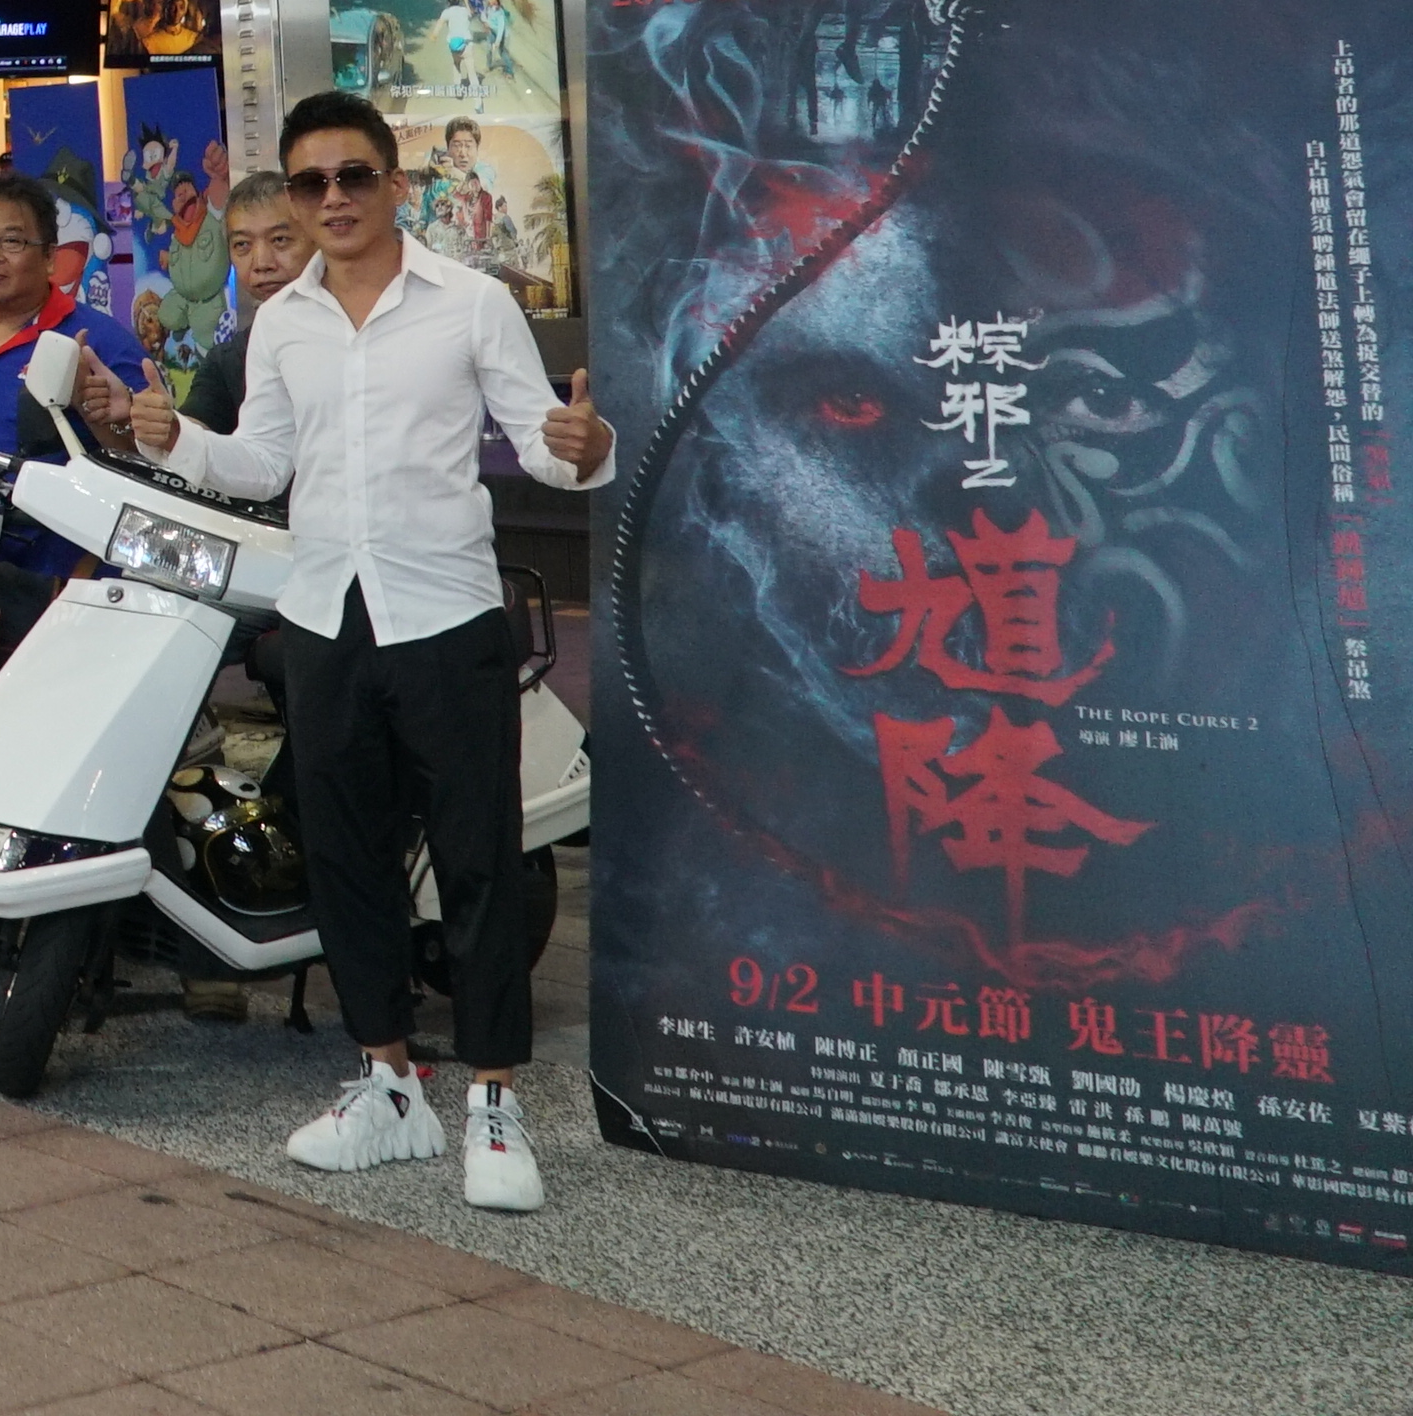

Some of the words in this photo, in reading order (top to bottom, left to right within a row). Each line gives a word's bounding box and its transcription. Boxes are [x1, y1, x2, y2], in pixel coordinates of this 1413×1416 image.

[151, 471, 233, 506] HONDA
[838, 507, 1158, 969] 馗降
[1075, 705, 1113, 721] THE
[1121, 708, 1170, 725] ROPE
[1177, 712, 1241, 730] CURSE
[1247, 717, 1259, 731] 2
[657, 1014, 716, 1042] 李康生
[813, 1034, 878, 1063] 陳博正
[897, 1045, 964, 1075] 顏正國
[1162, 1080, 1236, 1112] 楊慶煌
[1256, 1094, 1334, 1126] 孫安佐
[728, 955, 820, 1017] 9/2
[852, 970, 1034, 1045] 中元節
[1067, 993, 1336, 1085] 鬼王降靈
